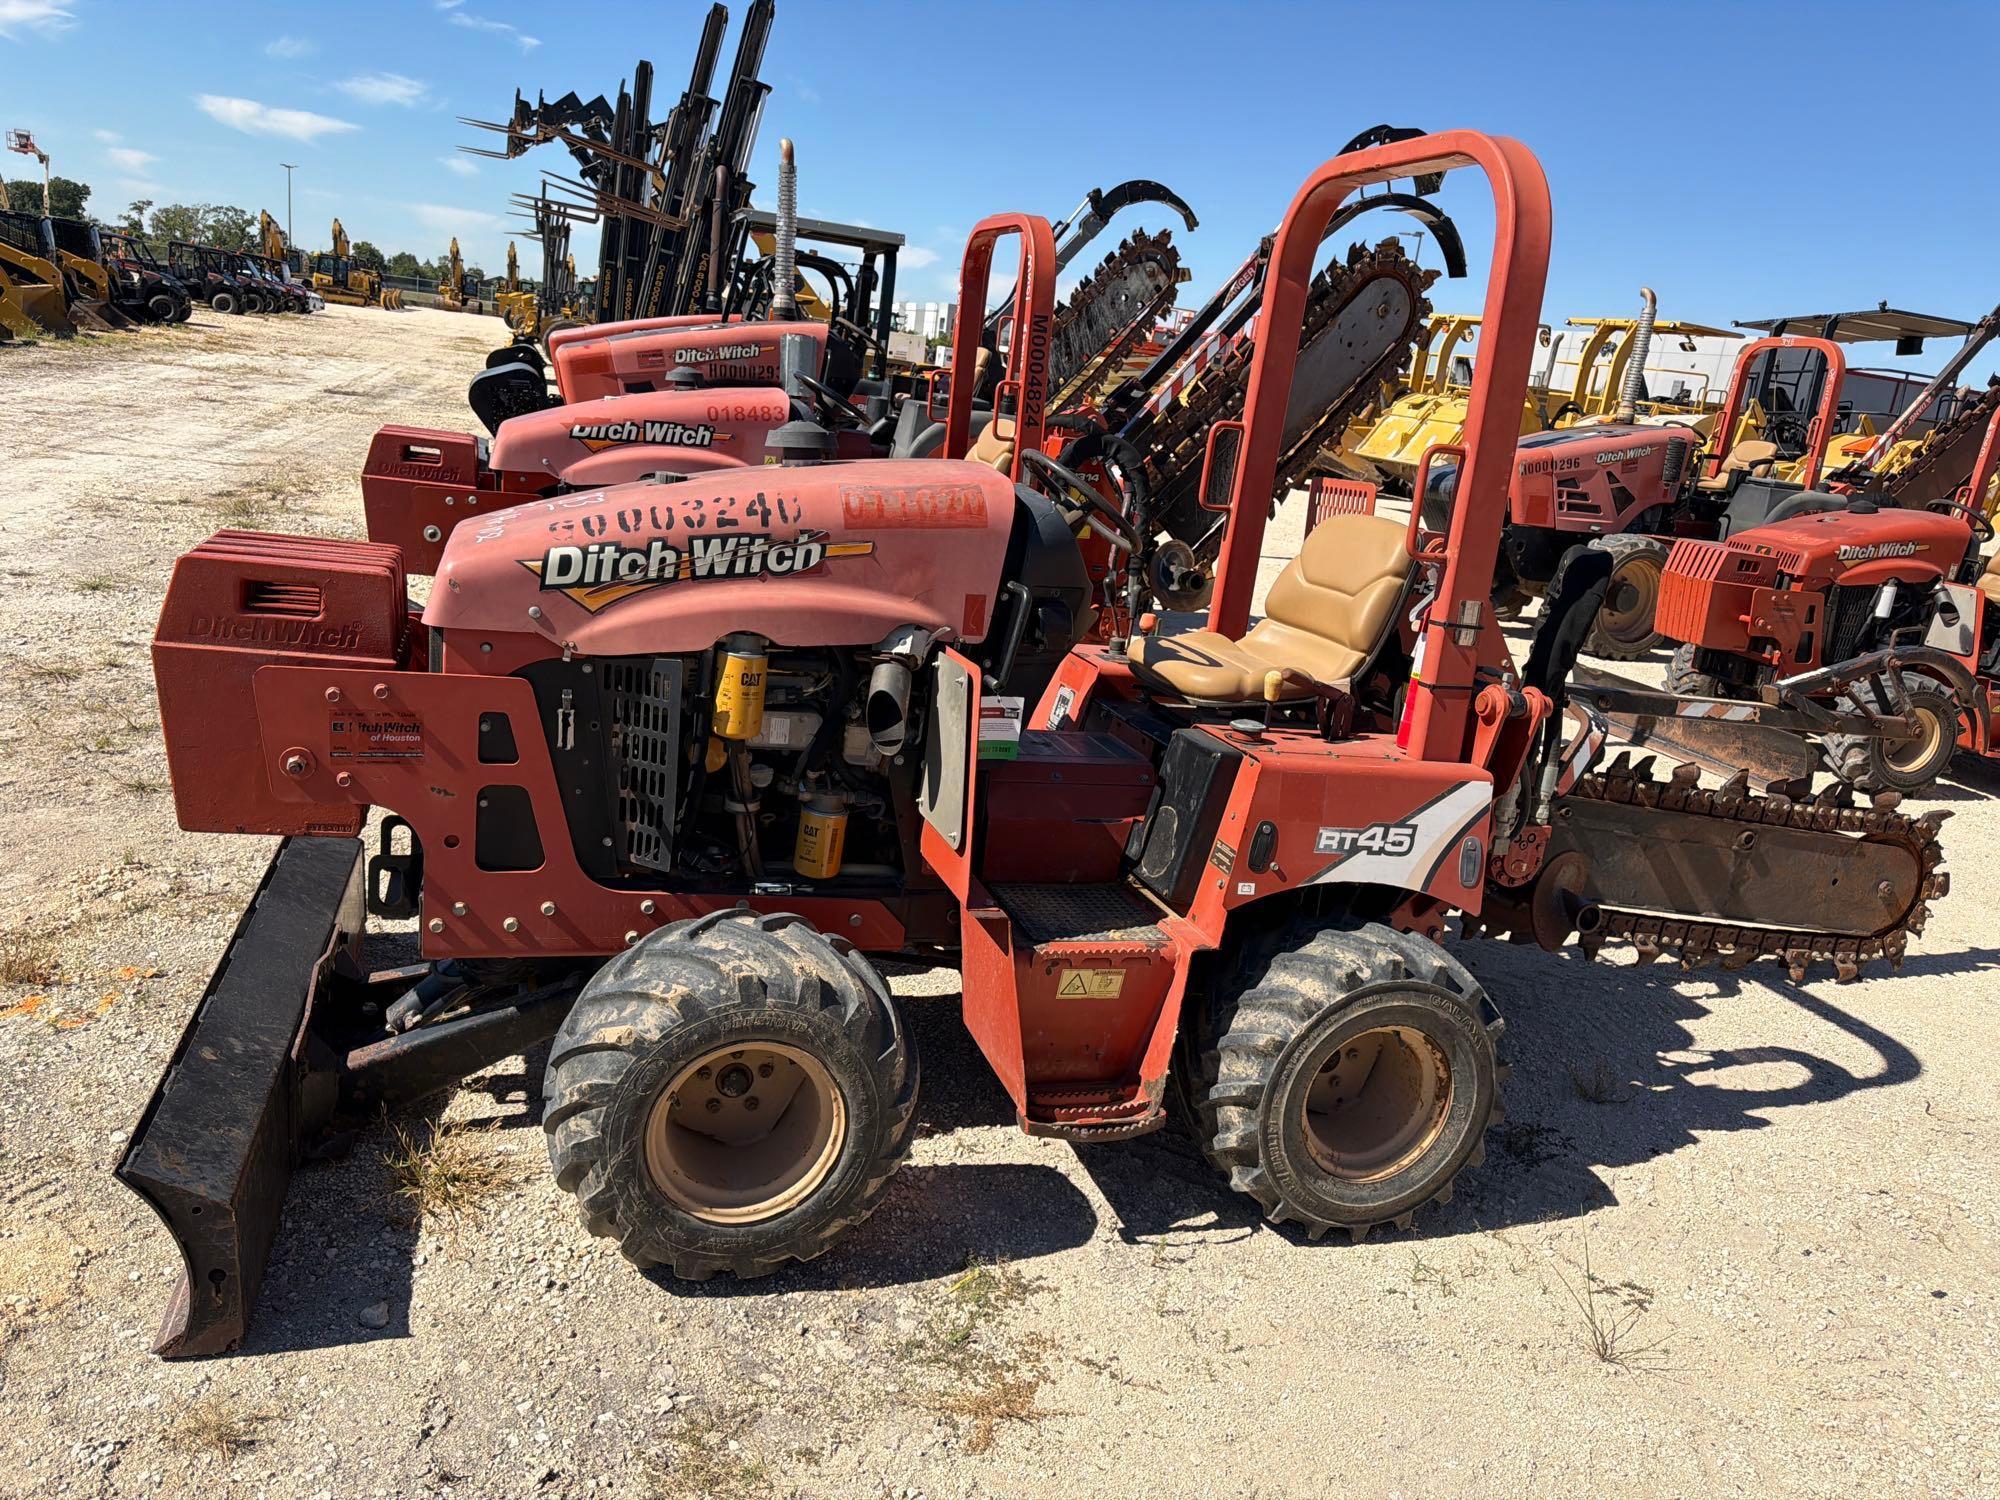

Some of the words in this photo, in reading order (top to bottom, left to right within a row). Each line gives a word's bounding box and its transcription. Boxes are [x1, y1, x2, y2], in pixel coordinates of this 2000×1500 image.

[675, 347, 715, 363] Ditch
[719, 344, 760, 360] Witch
[1024, 314, 1049, 429] M0004824
[706, 406, 785, 422] 018483
[645, 424, 711, 446] Witch
[1597, 451, 1625, 464] Ditch
[1627, 447, 1651, 460] Witch
[544, 541, 677, 586] Ditch
[692, 534, 822, 577] Witch
[1838, 544, 1876, 561] Ditch
[1878, 541, 1915, 556] Witch
[741, 672, 761, 687] CAT
[370, 734, 380, 742] of
[382, 733, 421, 742] Houston
[803, 824, 820, 838] CAT
[1319, 827, 1412, 852] RT45
